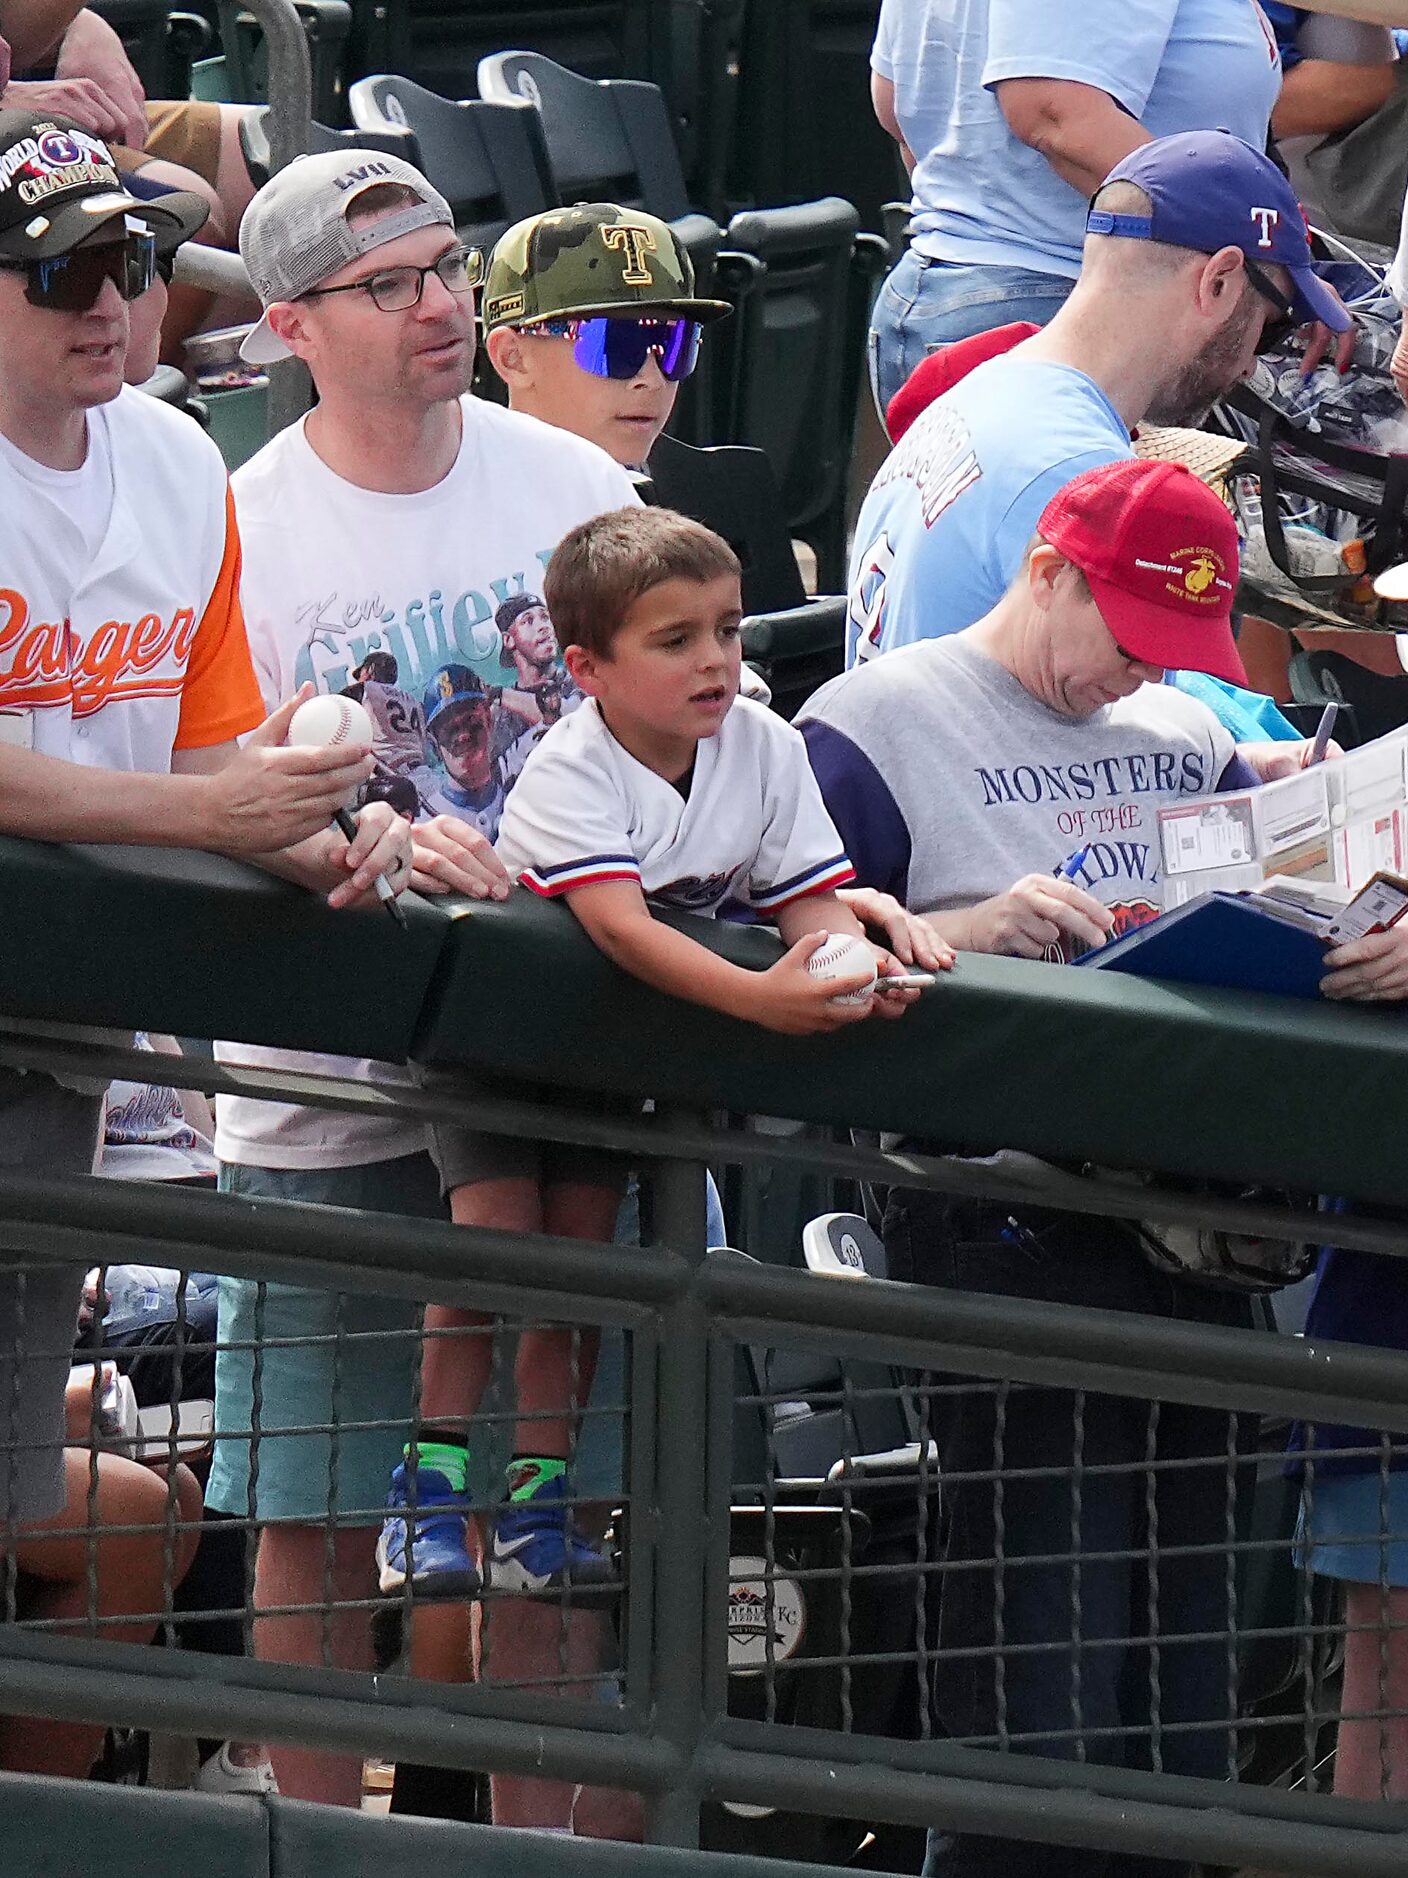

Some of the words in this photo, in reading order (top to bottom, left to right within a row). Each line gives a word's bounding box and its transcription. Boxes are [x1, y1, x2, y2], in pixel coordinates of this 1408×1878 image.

[332, 161, 392, 191] LVII
[1251, 207, 1279, 248] T
[600, 224, 657, 286] T
[295, 591, 388, 647] Ken
[0, 588, 196, 719] anger
[974, 752, 1206, 806] MONSTERS
[1057, 811, 1087, 837] OF
[1091, 803, 1142, 835] THE
